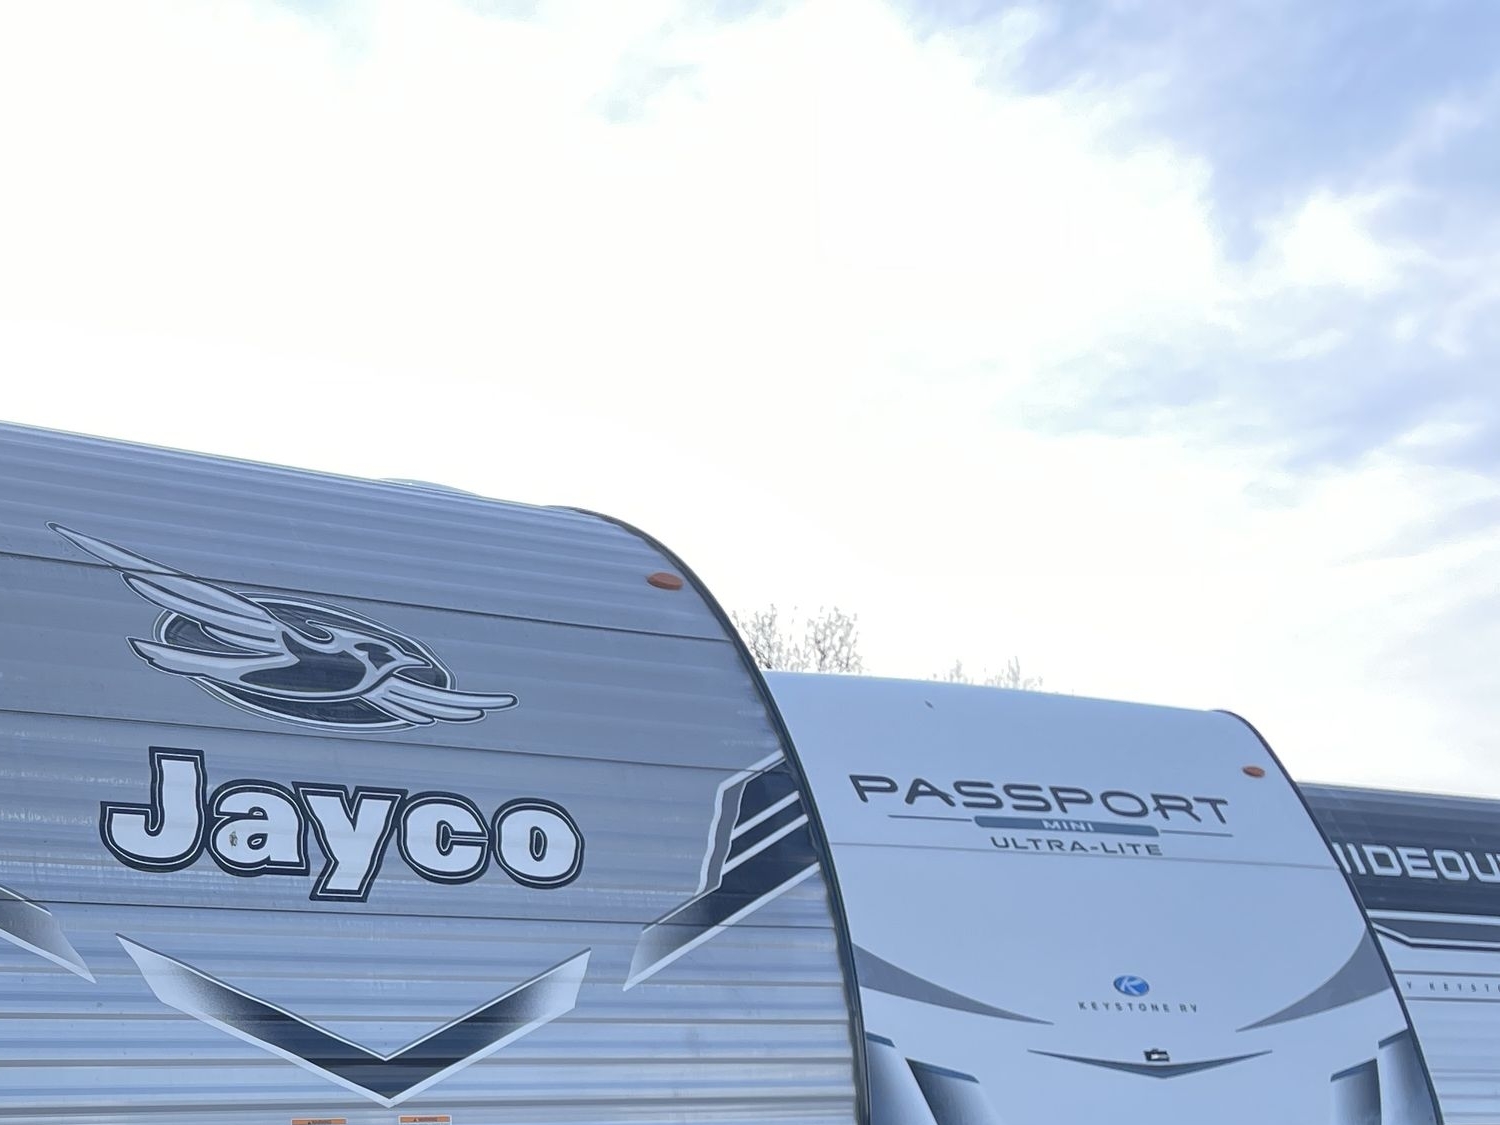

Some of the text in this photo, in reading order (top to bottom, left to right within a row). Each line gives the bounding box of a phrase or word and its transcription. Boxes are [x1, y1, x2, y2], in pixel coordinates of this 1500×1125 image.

[848, 774, 1229, 824] PASSPORT
[100, 746, 585, 902] Jayco
[1041, 819, 1095, 833] MINI
[990, 836, 1163, 857] ULTRA-LITE
[1332, 842, 1500, 883] IDEOU
[1078, 1001, 1198, 1013] KEYSTONE RV
